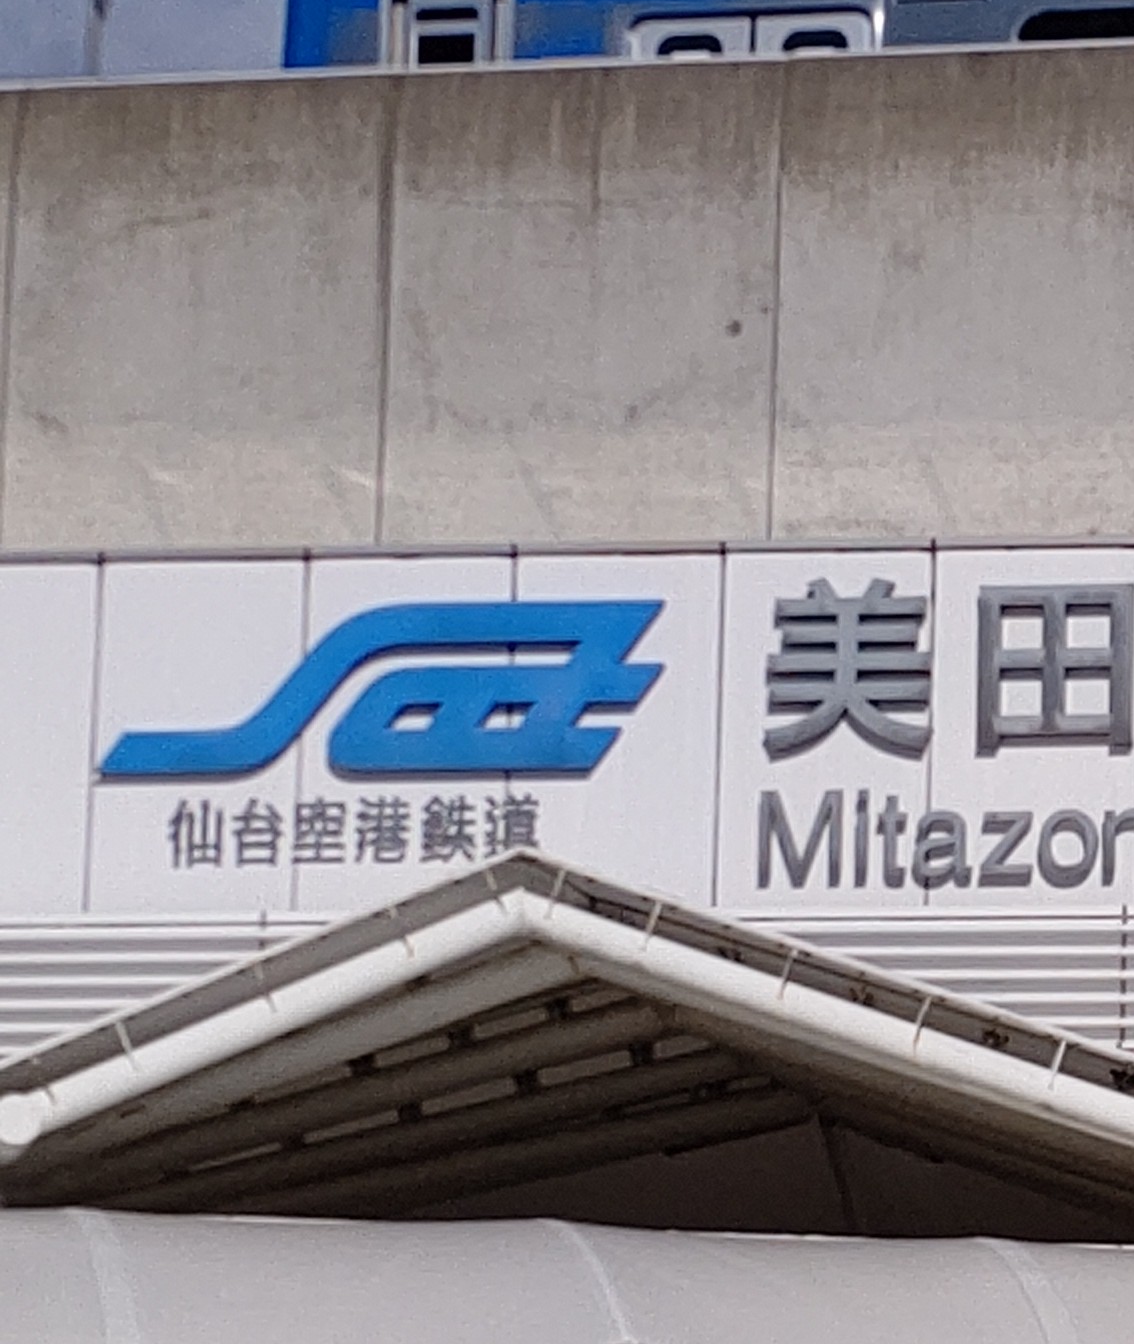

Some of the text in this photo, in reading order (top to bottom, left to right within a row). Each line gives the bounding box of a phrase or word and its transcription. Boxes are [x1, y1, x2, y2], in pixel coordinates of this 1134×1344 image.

[167, 794, 541, 869] 仙台空港鉄道
